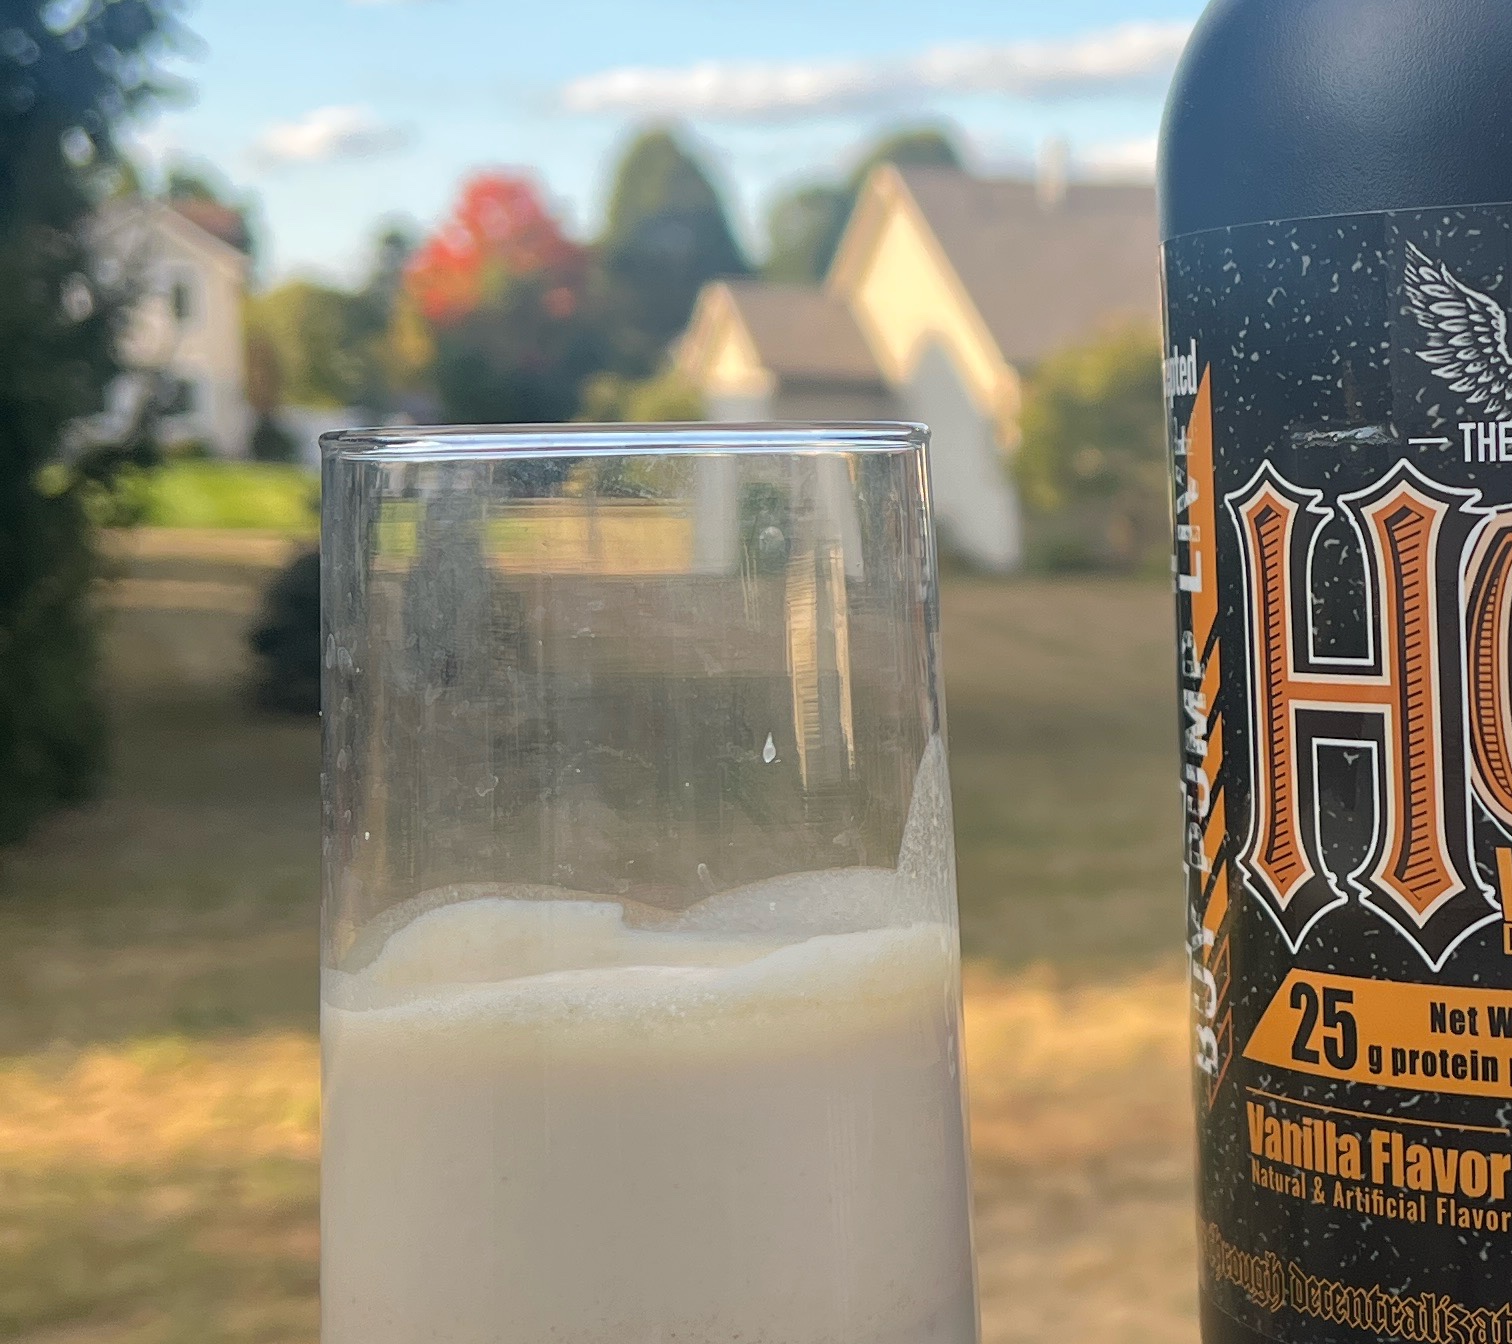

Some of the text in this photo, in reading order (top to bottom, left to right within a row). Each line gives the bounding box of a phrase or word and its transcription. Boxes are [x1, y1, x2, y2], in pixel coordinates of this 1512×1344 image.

[1181, 629, 1213, 873] PUMP
[1190, 903, 1219, 1077] BUY
[1288, 981, 1357, 1071] 25
[1429, 1001, 1479, 1037] Net
[1368, 1045, 1383, 1074] g
[1392, 1045, 1499, 1084] protein
[1246, 1101, 1512, 1200] Vanilla Flavor
[1251, 1158, 1512, 1233] Natural & Artificial Flavor
